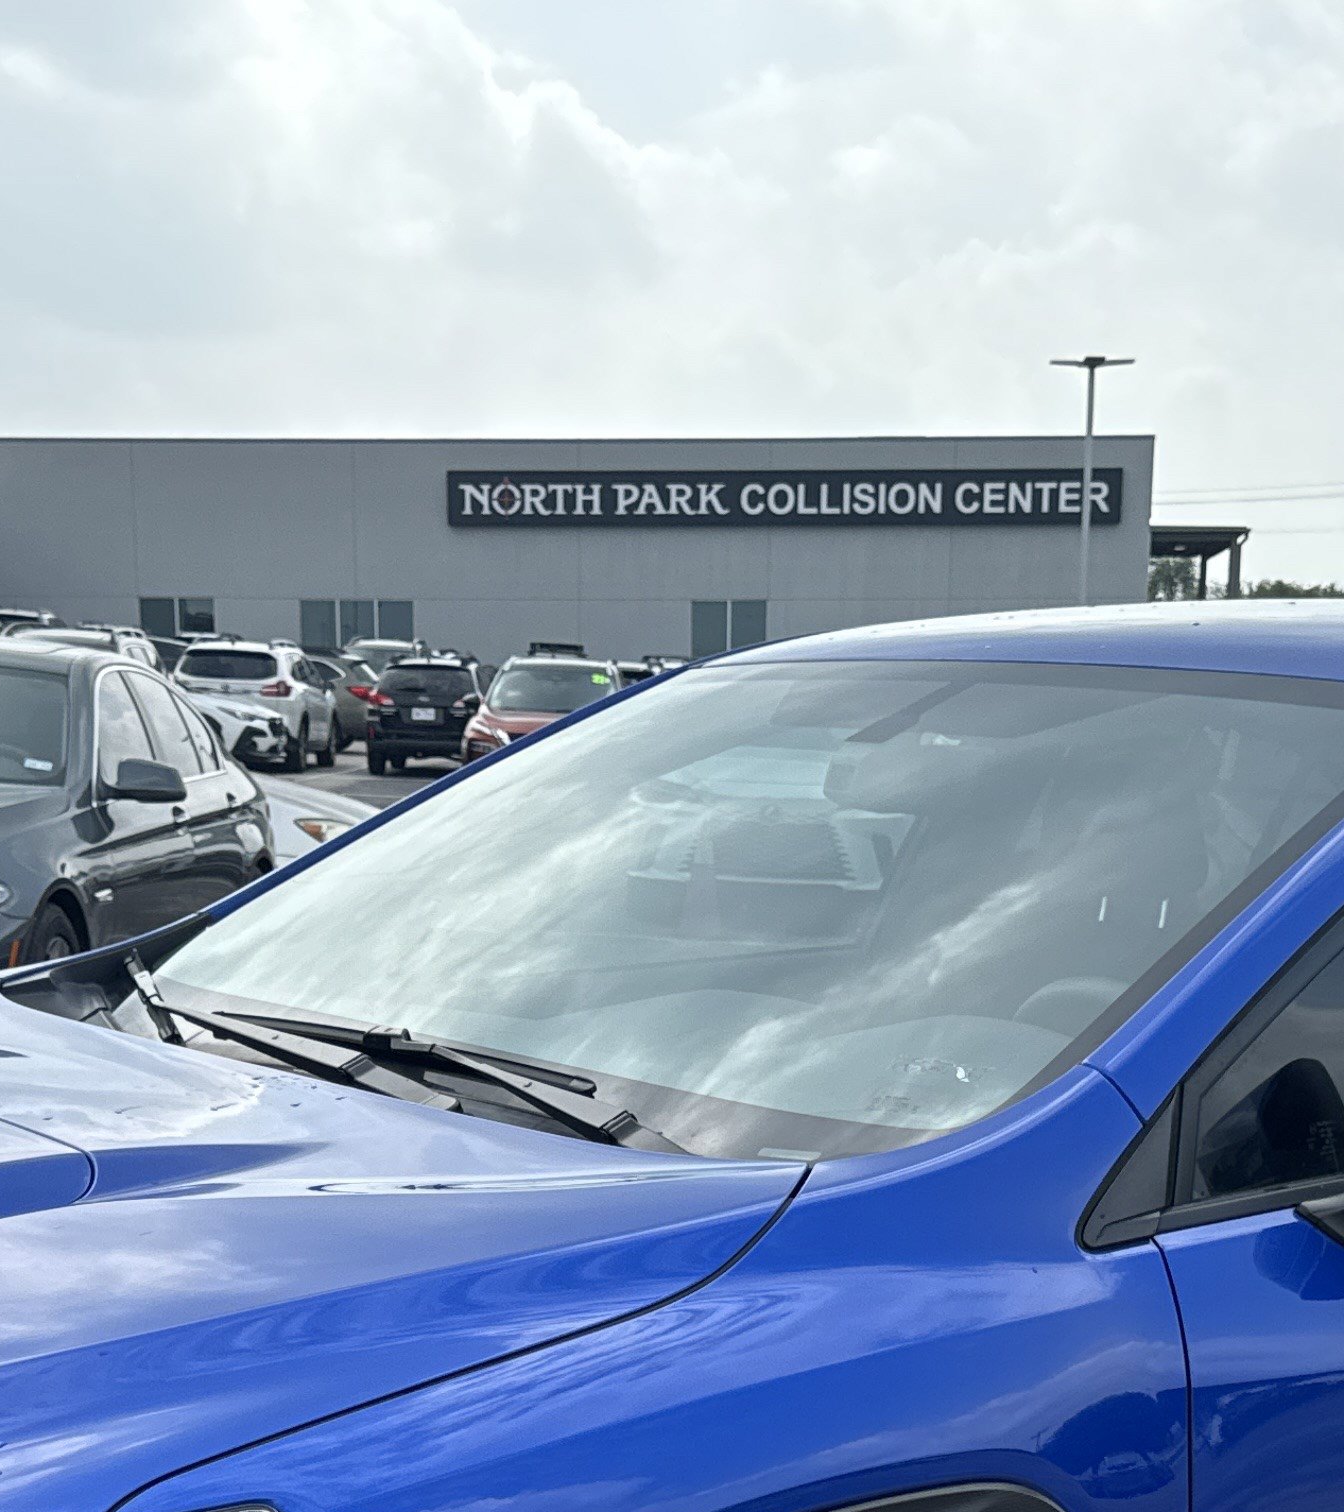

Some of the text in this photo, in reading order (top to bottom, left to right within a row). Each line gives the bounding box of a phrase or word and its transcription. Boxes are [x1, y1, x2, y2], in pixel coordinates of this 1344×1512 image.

[458, 481, 1110, 516] NORTH PARK COLLISION CENTER
